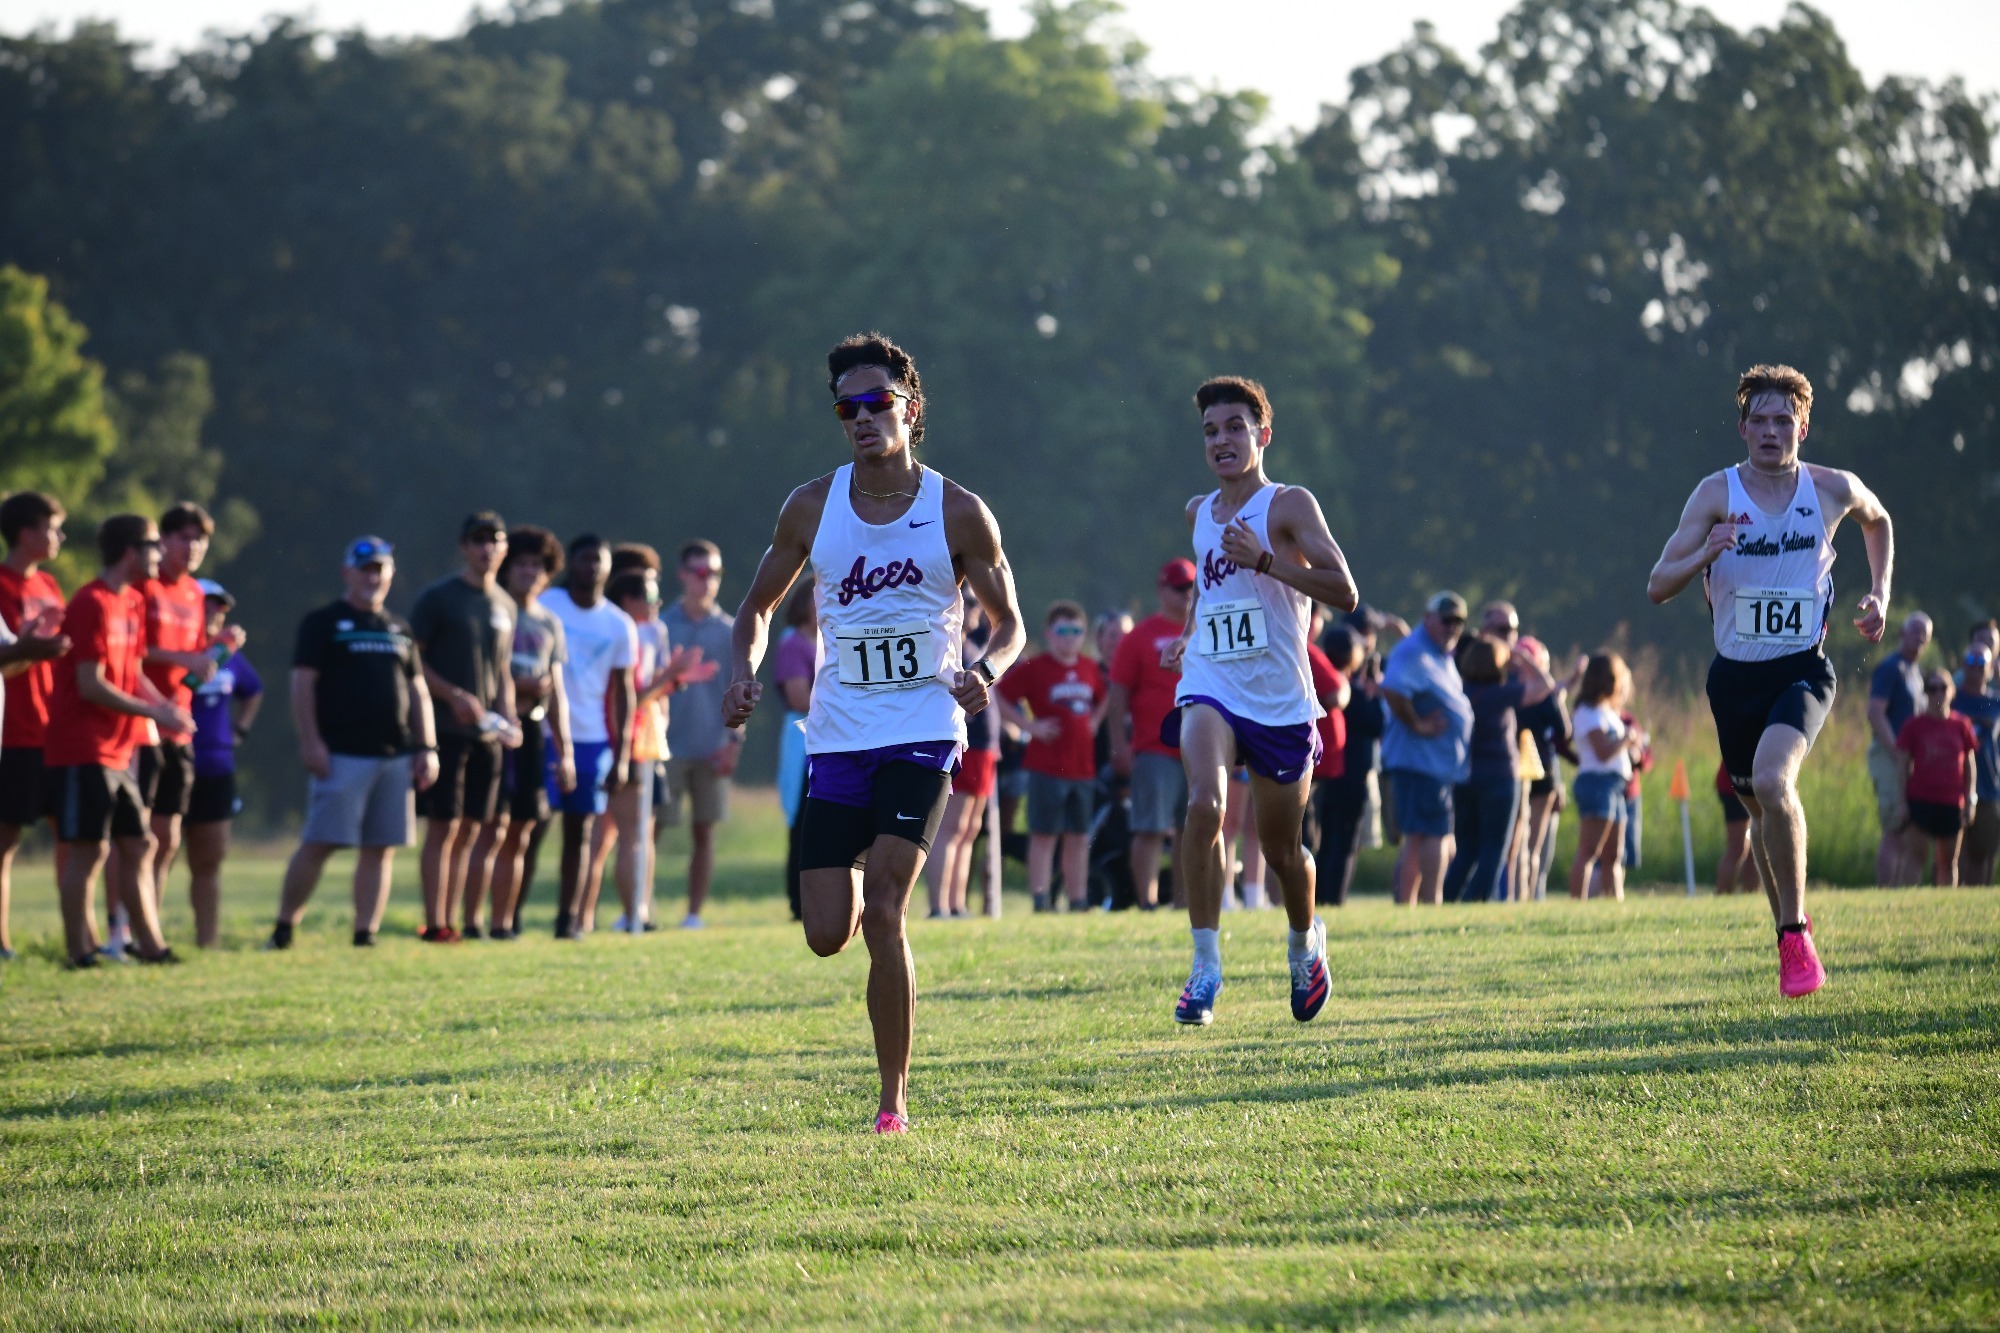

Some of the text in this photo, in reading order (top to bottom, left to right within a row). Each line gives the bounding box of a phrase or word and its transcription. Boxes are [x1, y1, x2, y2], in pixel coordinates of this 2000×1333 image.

[1736, 529, 1816, 556] Southern Indiana
[837, 555, 924, 606] Aces
[1203, 548, 1239, 590] Ace
[1207, 612, 1255, 652] 114
[1749, 600, 1803, 635] 164
[853, 637, 919, 682] 113
